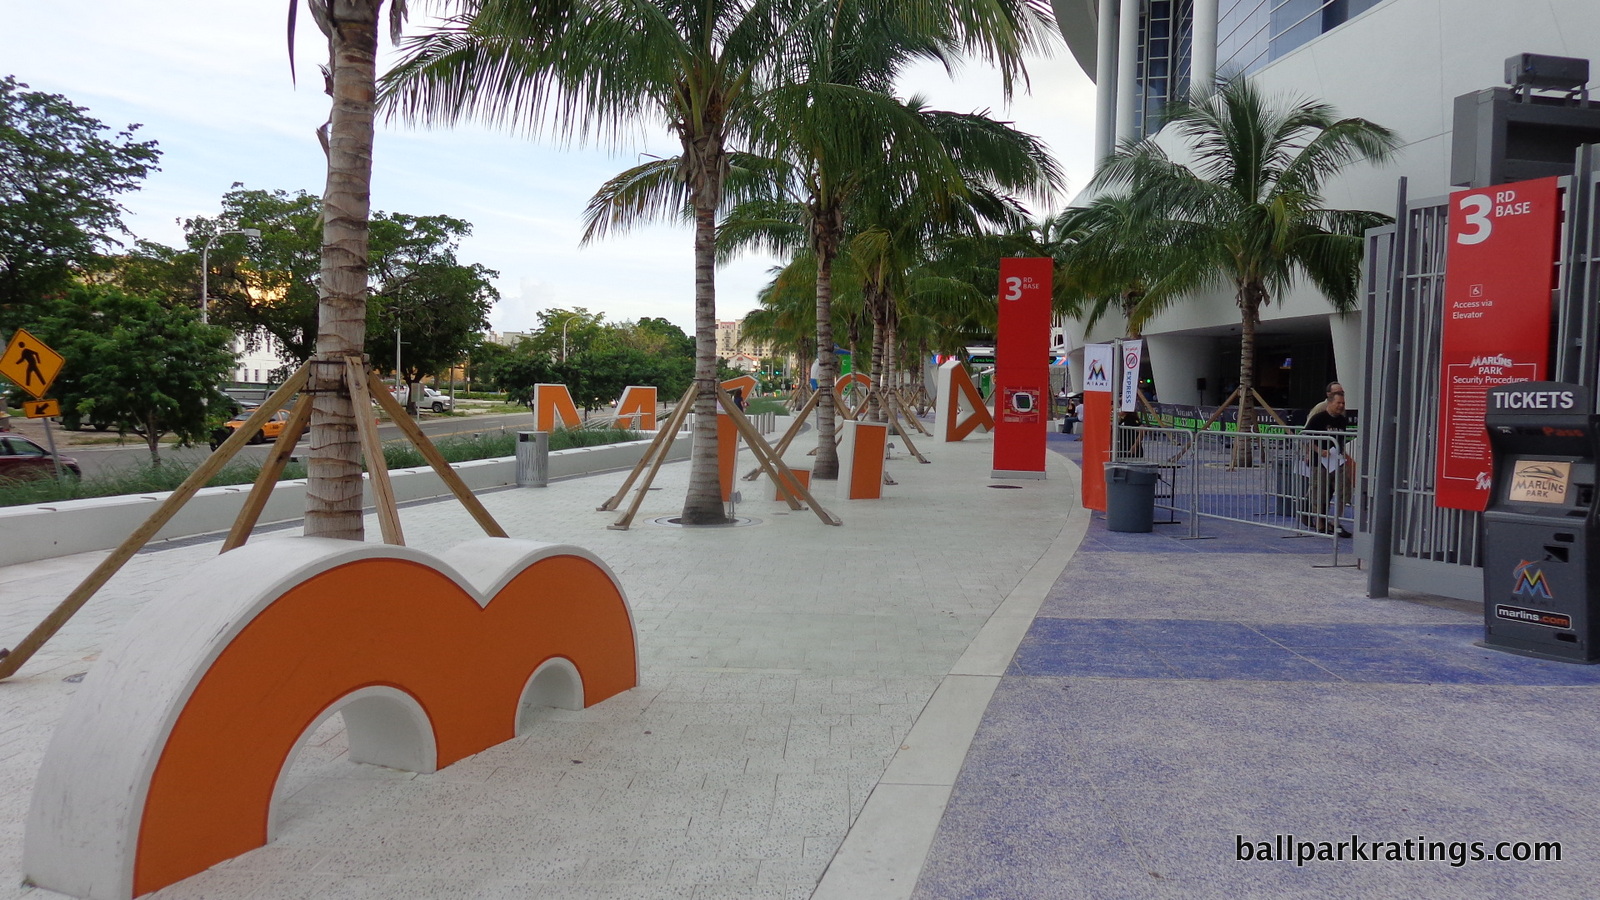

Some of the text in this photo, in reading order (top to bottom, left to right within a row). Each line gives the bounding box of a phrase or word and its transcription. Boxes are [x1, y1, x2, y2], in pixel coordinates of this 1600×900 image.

[1496, 202, 1531, 217] BASE
[1457, 191, 1515, 245] 3 RD
[1004, 276, 1023, 301] 3
[1452, 299, 1493, 309] Access via
[1452, 311, 1483, 320] Elevator
[1469, 354, 1513, 368] MARLINS
[1478, 366, 1502, 375] PARK
[1453, 375, 1529, 385] Security Procedures
[1493, 391, 1574, 408] TICKETS
[1514, 480, 1565, 494] MARLINS
[1525, 489, 1549, 498] PARK
[1498, 608, 1568, 625] marlins.com
